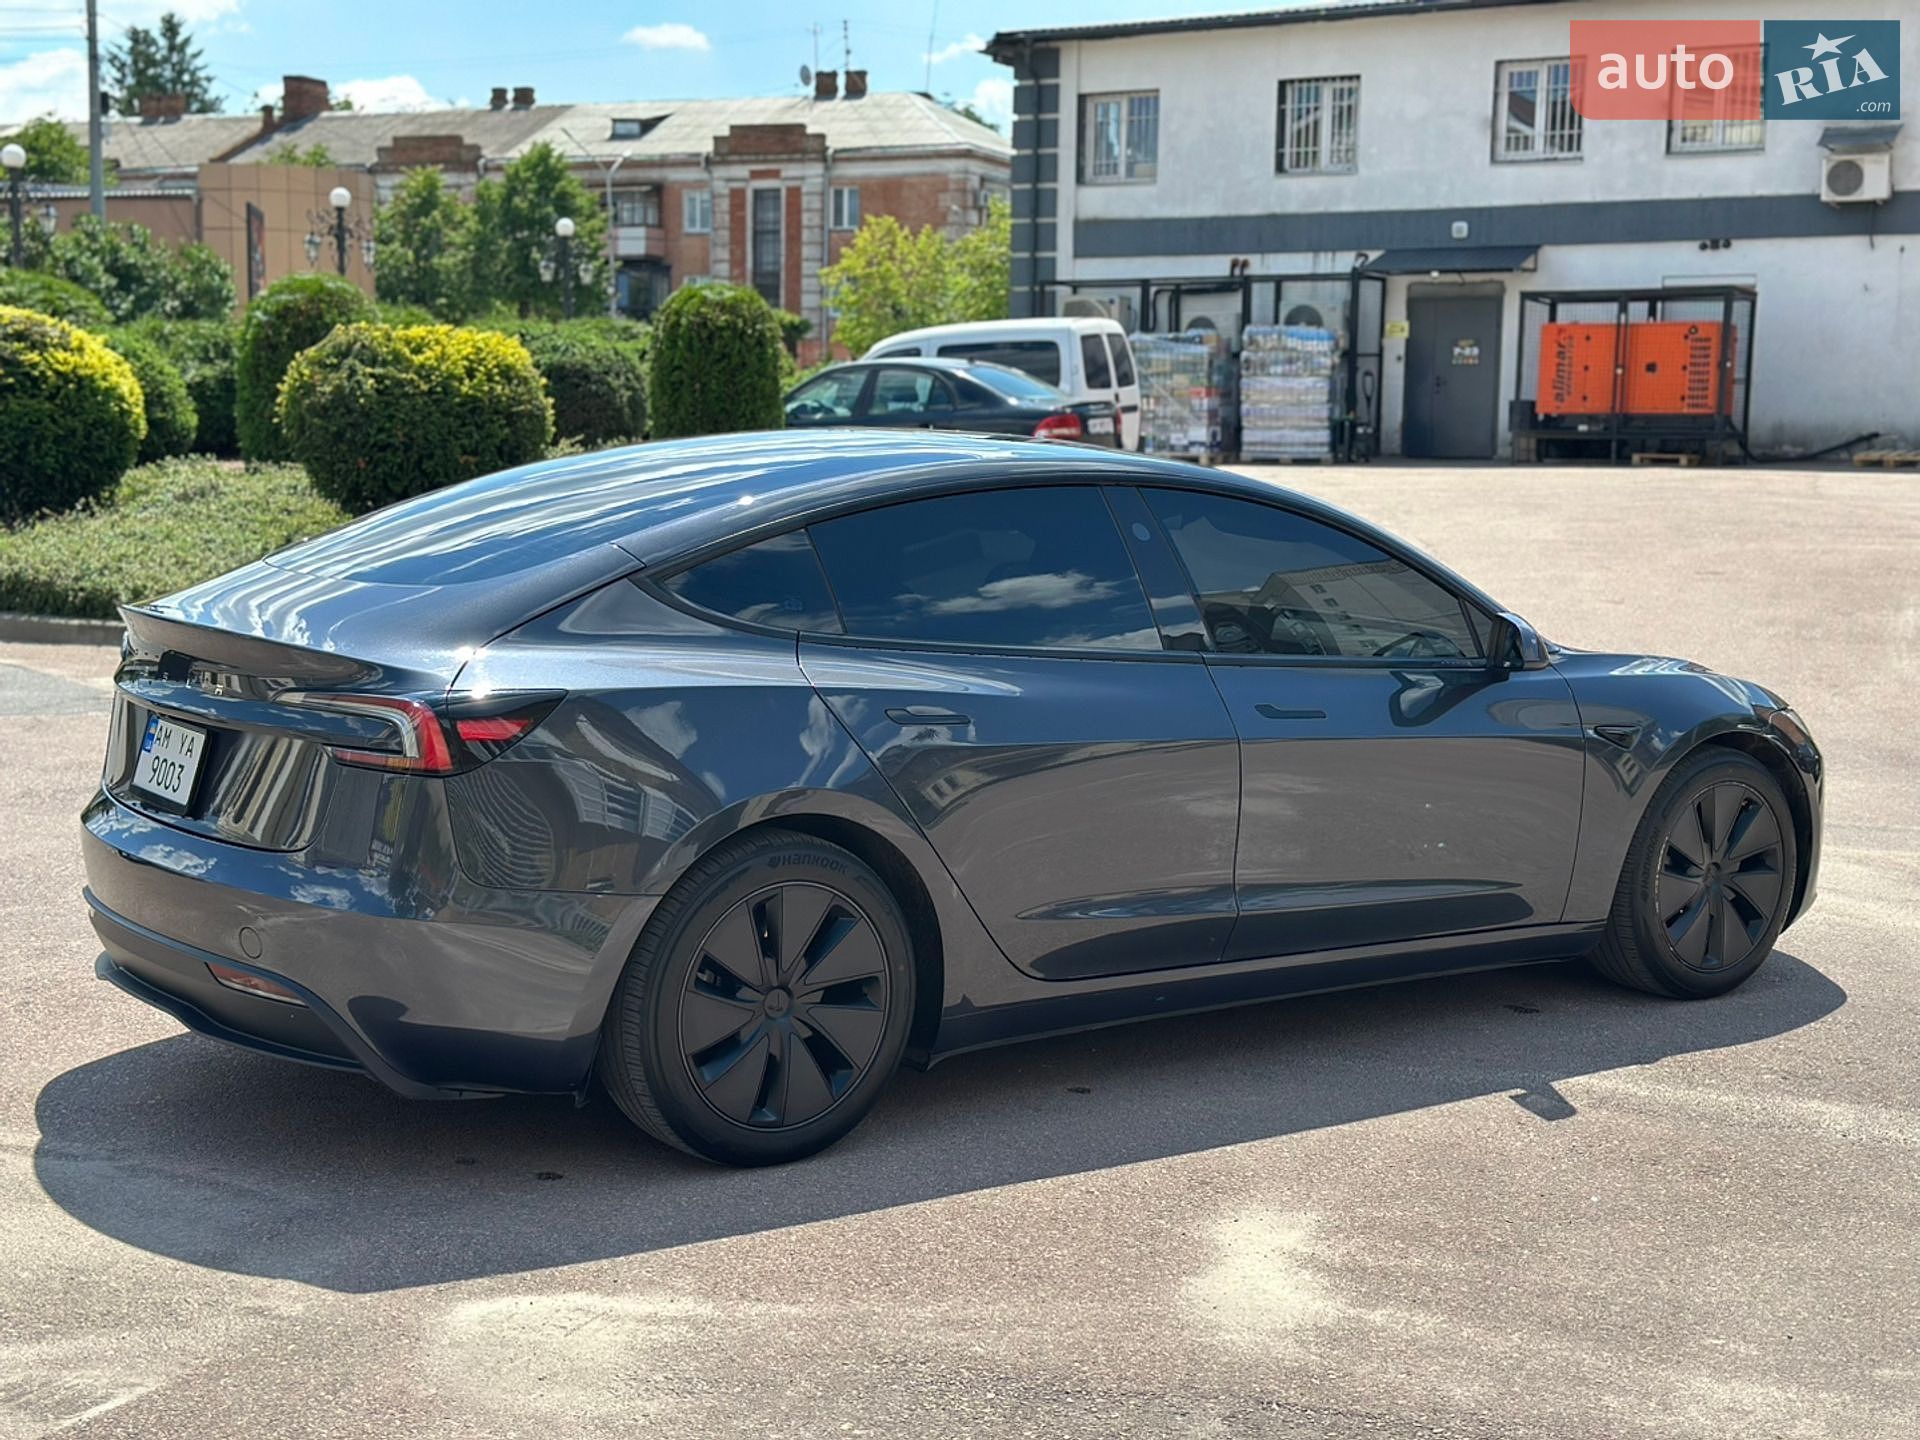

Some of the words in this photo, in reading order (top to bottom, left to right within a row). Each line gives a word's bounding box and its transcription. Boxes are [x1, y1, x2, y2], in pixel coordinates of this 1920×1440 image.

[154, 725, 172, 749] AM
[178, 733, 195, 758] YA
[148, 755, 185, 793] 9003
